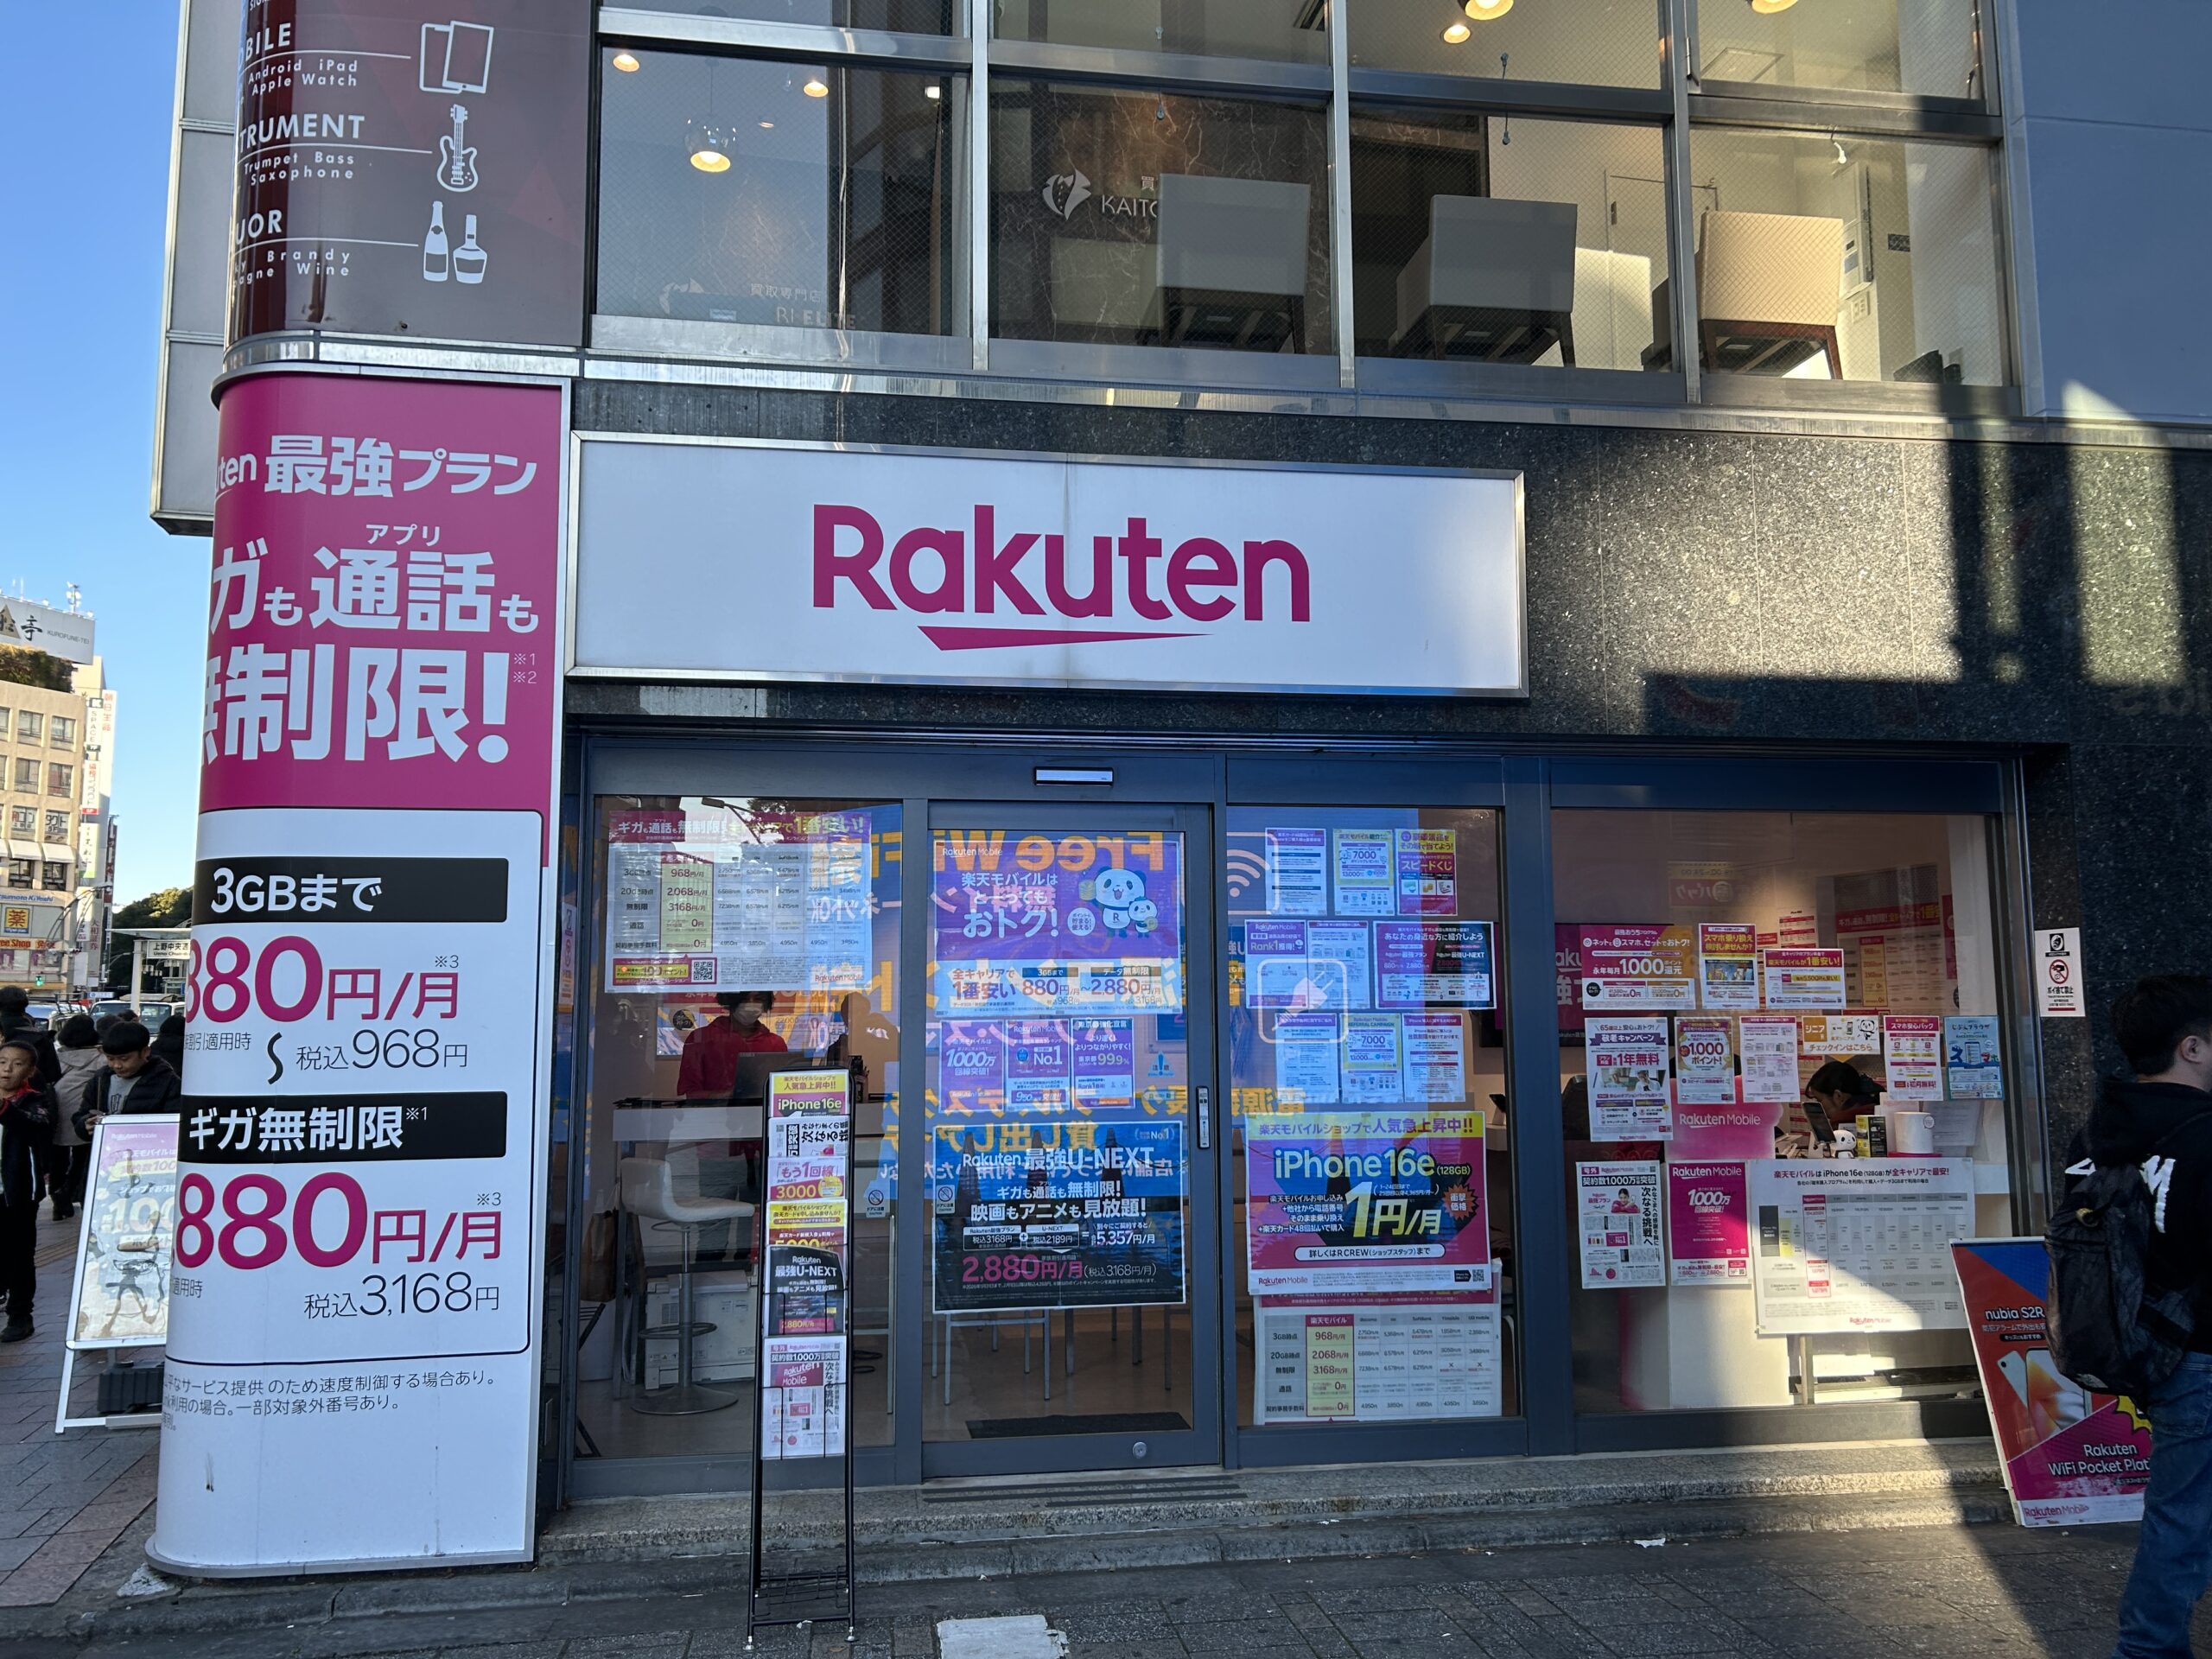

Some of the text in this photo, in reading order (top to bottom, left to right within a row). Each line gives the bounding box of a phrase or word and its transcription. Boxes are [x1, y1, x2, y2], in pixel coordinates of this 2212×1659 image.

[248, 59, 358, 84] Android iPad
[251, 73, 357, 96] Apple Watch
[244, 151, 354, 175] Trumpet Bass
[251, 166, 353, 186] Saxophone
[267, 249, 350, 264] Brandy
[297, 263, 349, 276] Wine
[264, 435, 537, 498] 最強プラン
[366, 524, 441, 546] アプリ
[813, 504, 1311, 624] Rakuten
[943, 848, 1002, 857] Rakuten Mobile
[1402, 861, 1452, 871] スピードくじ
[962, 873, 1058, 886] 楽天モバイルは
[210, 867, 382, 913] 3GBまで
[8, 910, 27, 927] 薬
[963, 909, 1059, 938] おトク!
[296, 1028, 468, 1072] 税込968円
[189, 1107, 404, 1152] ギガ無制限
[1679, 1114, 1761, 1127] Rakuten Mobile
[963, 1154, 1021, 1169] Rakuten
[1672, 1166, 1742, 1179] Rakuten Mobile
[970, 1198, 1147, 1222] 映画もアニメも見放題!
[1345, 1181, 1442, 1238] 1円/月
[1259, 1276, 1287, 1287] Rakuten
[303, 1272, 499, 1319] 税込3,168円
[1985, 1306, 2045, 1320] nubia S2R
[2083, 1443, 2138, 1457] Rakuten
[2048, 1457, 2151, 1476] WiFi Pocket Plat
[2024, 1504, 2063, 1518] Rakuten
